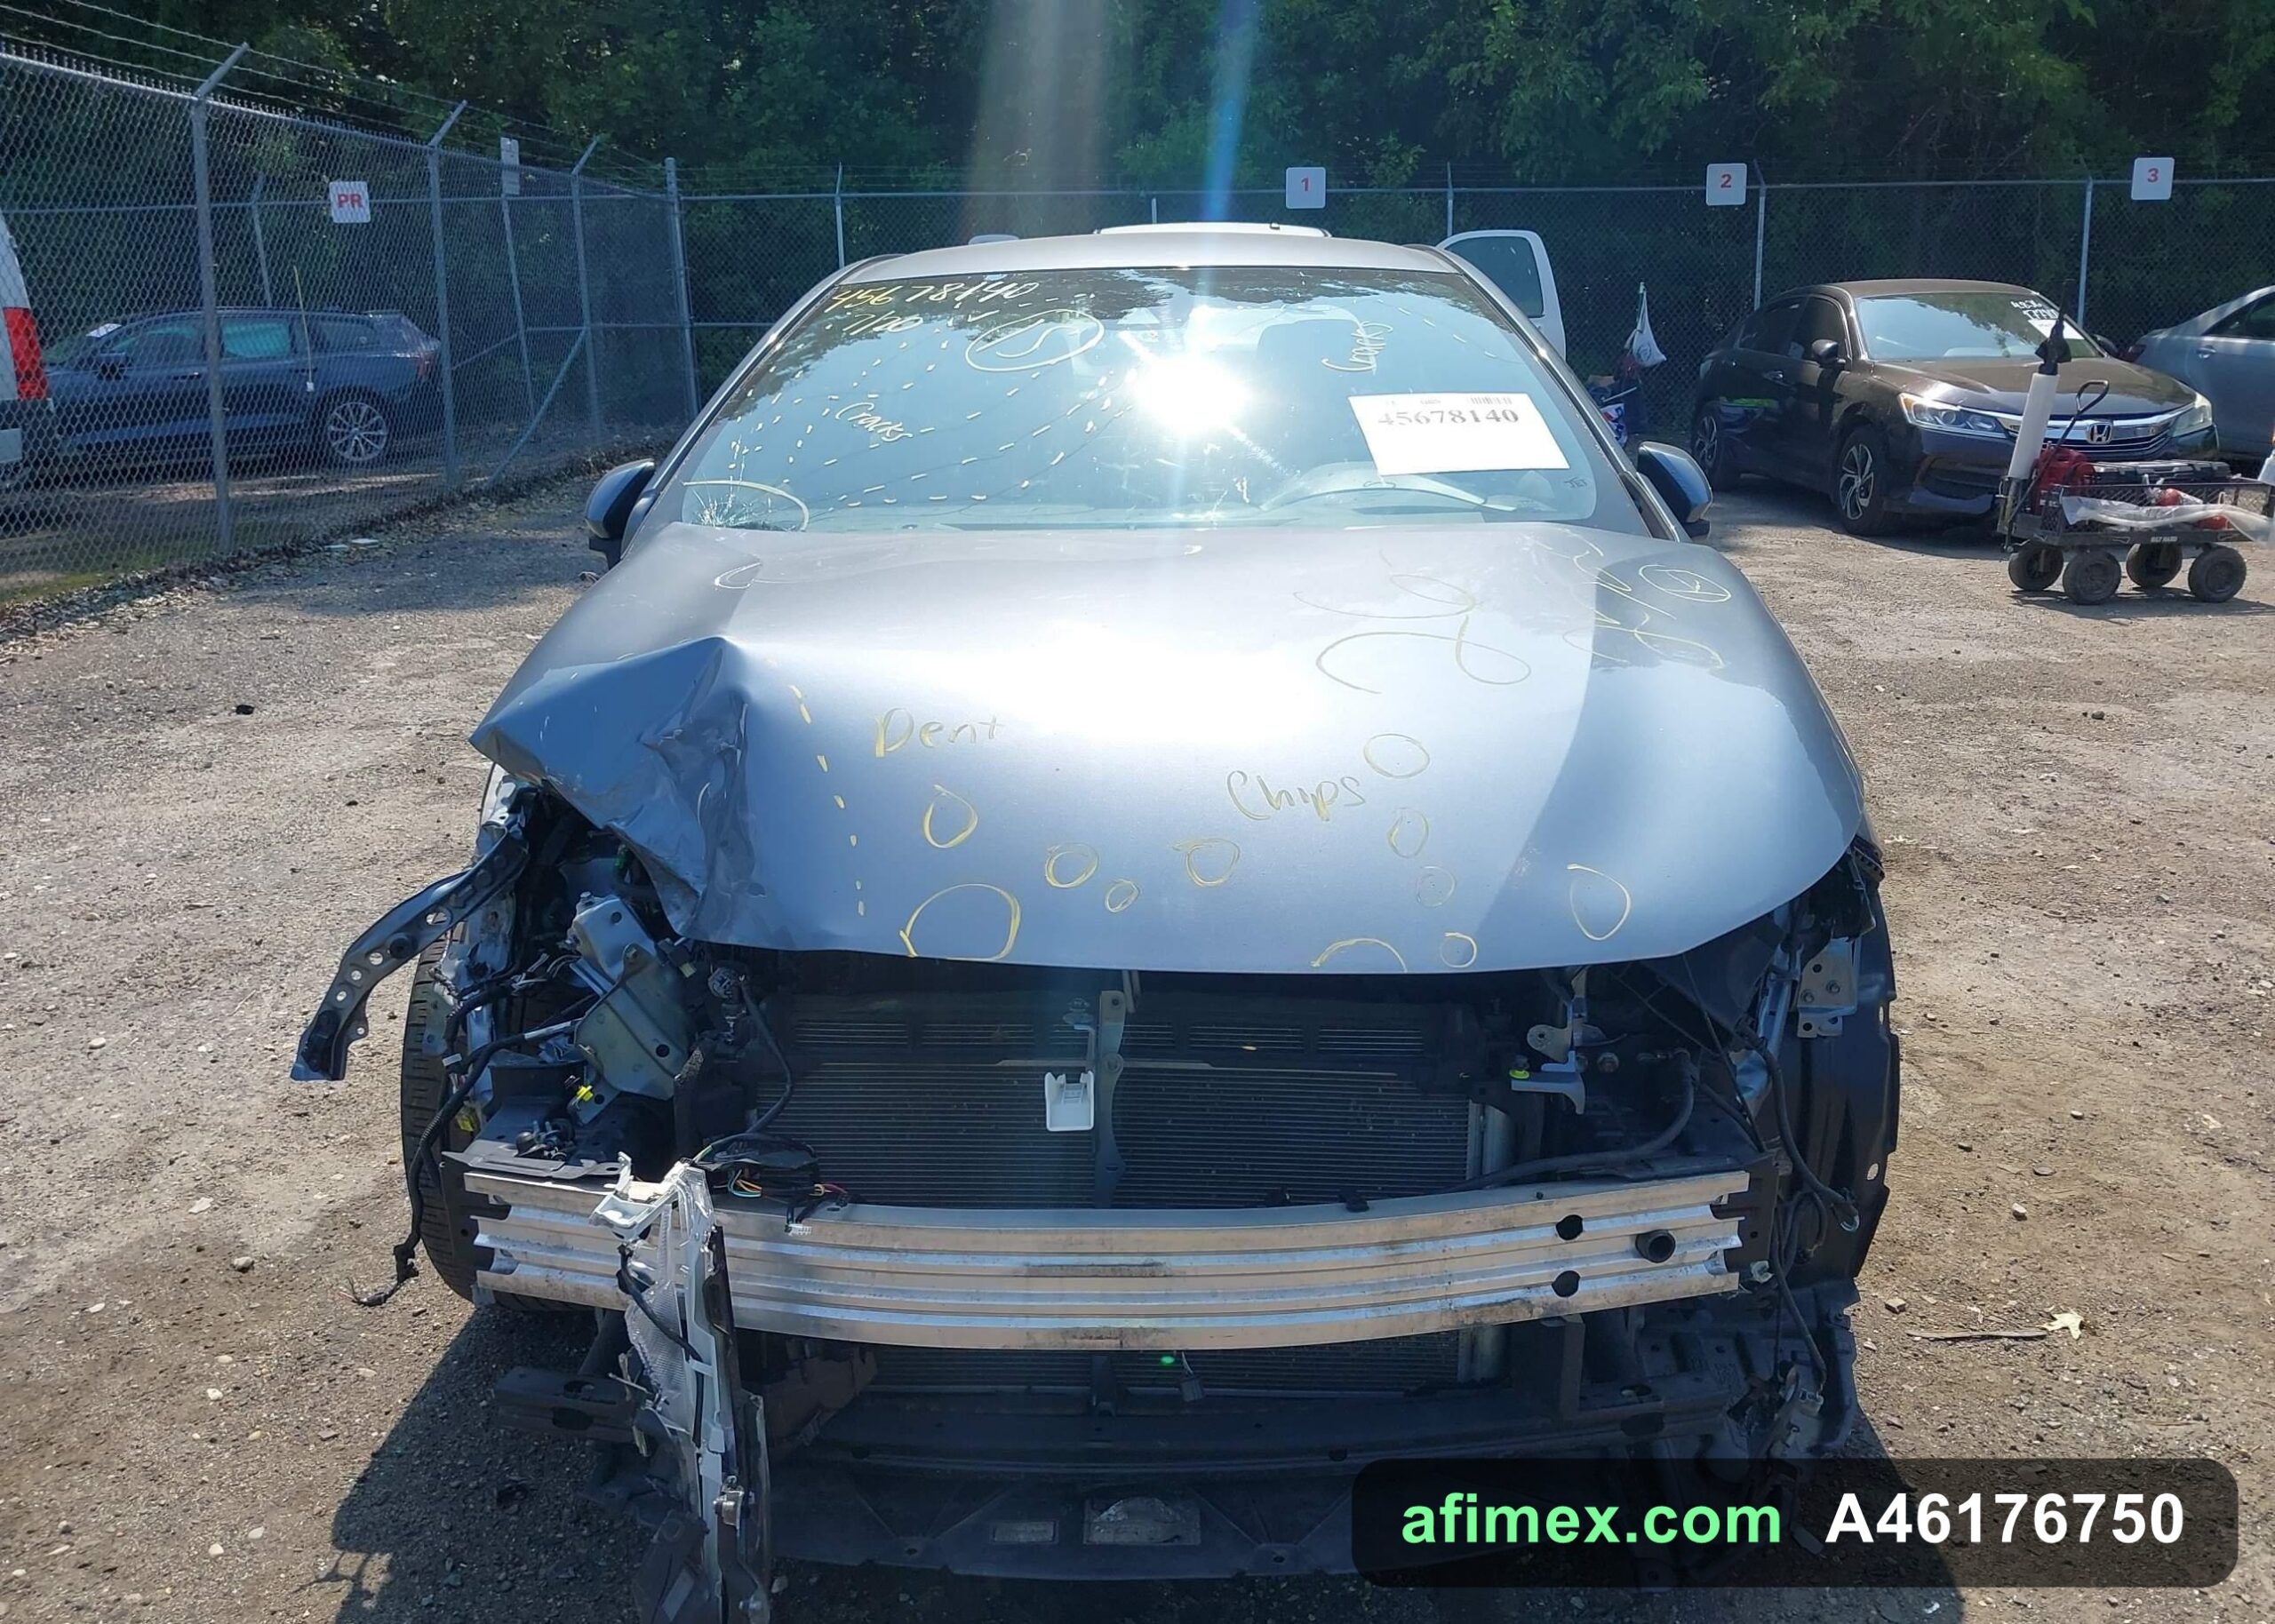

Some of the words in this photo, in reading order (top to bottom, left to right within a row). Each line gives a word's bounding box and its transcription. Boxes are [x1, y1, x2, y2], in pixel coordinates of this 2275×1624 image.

[1720, 173, 1732, 188] 2
[2147, 168, 2159, 183] 3
[1300, 177, 1309, 192] 1
[338, 193, 363, 209] PR
[1377, 408, 1520, 426] 45678140
[874, 707, 1006, 758] Dent
[1226, 769, 1366, 823] Chips
